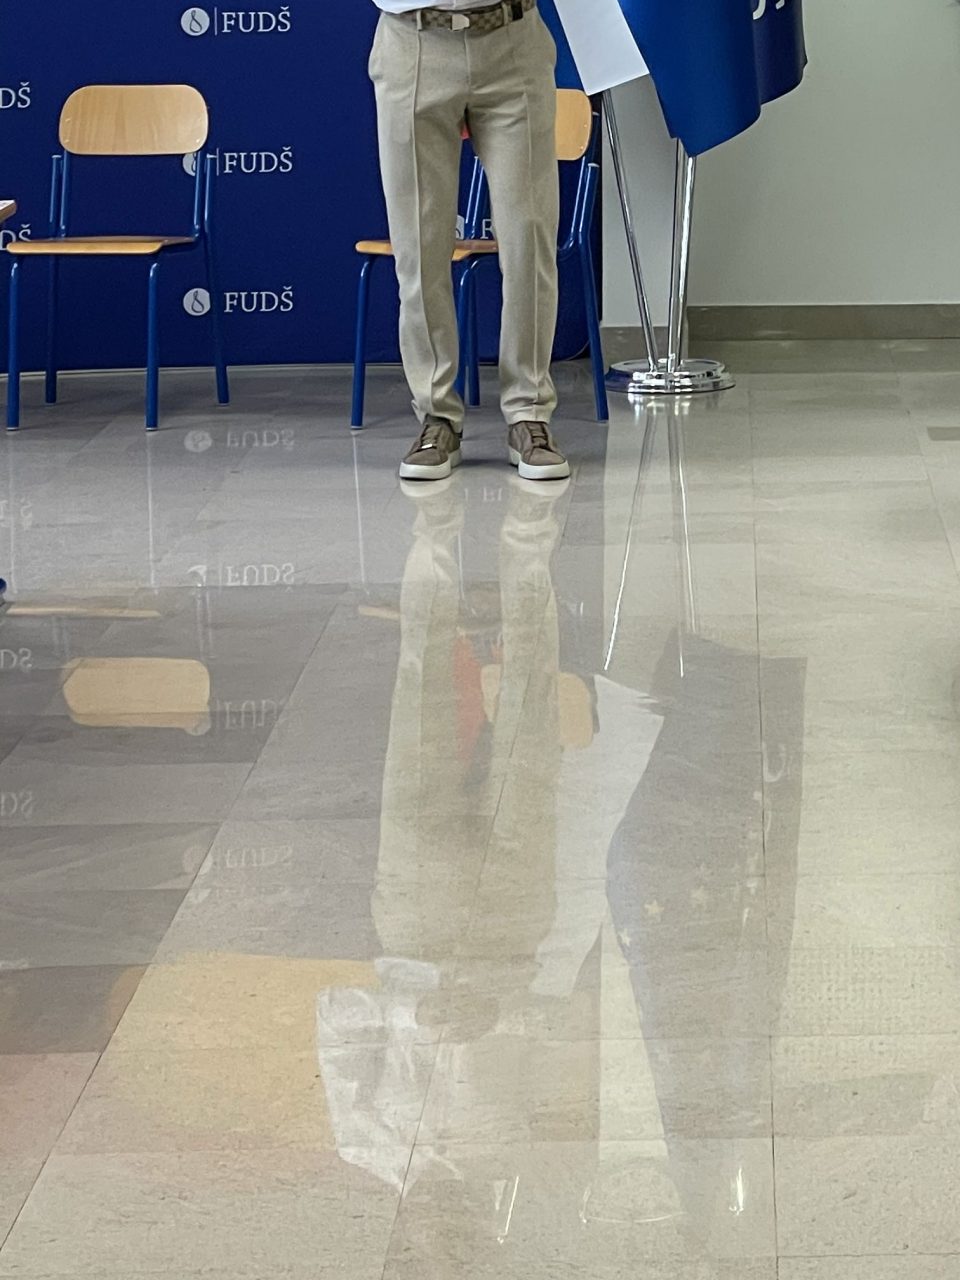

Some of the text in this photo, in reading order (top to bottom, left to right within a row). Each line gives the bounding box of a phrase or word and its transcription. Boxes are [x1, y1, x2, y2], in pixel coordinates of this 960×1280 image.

[221, 6, 291, 33] FUDŠ
[223, 146, 293, 174] FUDŠ
[223, 285, 293, 313] FUDŠ
